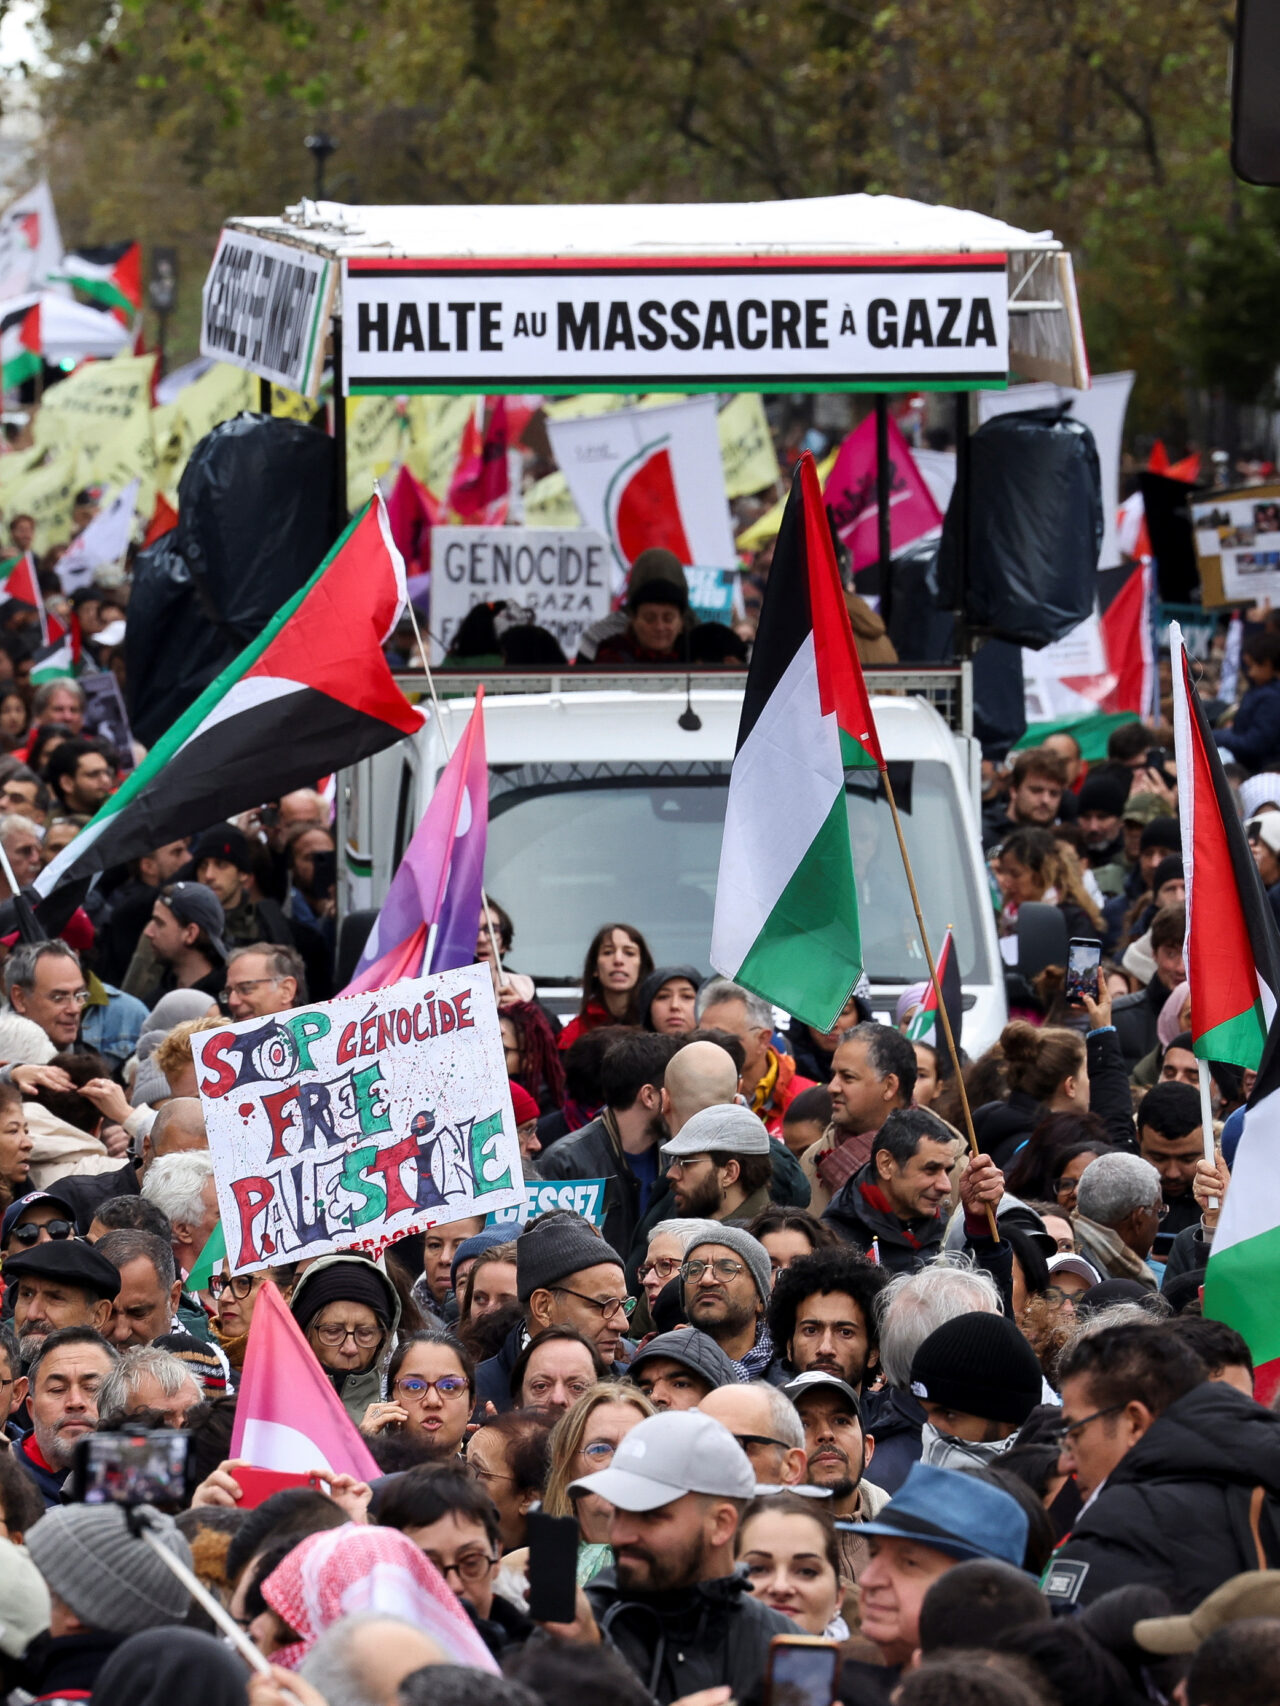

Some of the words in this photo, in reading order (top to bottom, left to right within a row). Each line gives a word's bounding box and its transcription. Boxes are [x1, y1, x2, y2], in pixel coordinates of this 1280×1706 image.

[357, 302, 503, 353] HALTE
[512, 311, 548, 339] AU
[556, 299, 830, 353] MASSACRE
[839, 302, 858, 337] À
[865, 297, 998, 350] GAZA
[445, 535, 603, 587] GÉNOCIDE
[526, 591, 593, 612] GAZA
[200, 1011, 332, 1098] STOP
[336, 988, 475, 1066] GÉNOCIDE
[259, 1060, 393, 1164] FREE
[228, 1109, 515, 1271] PALESTINE
